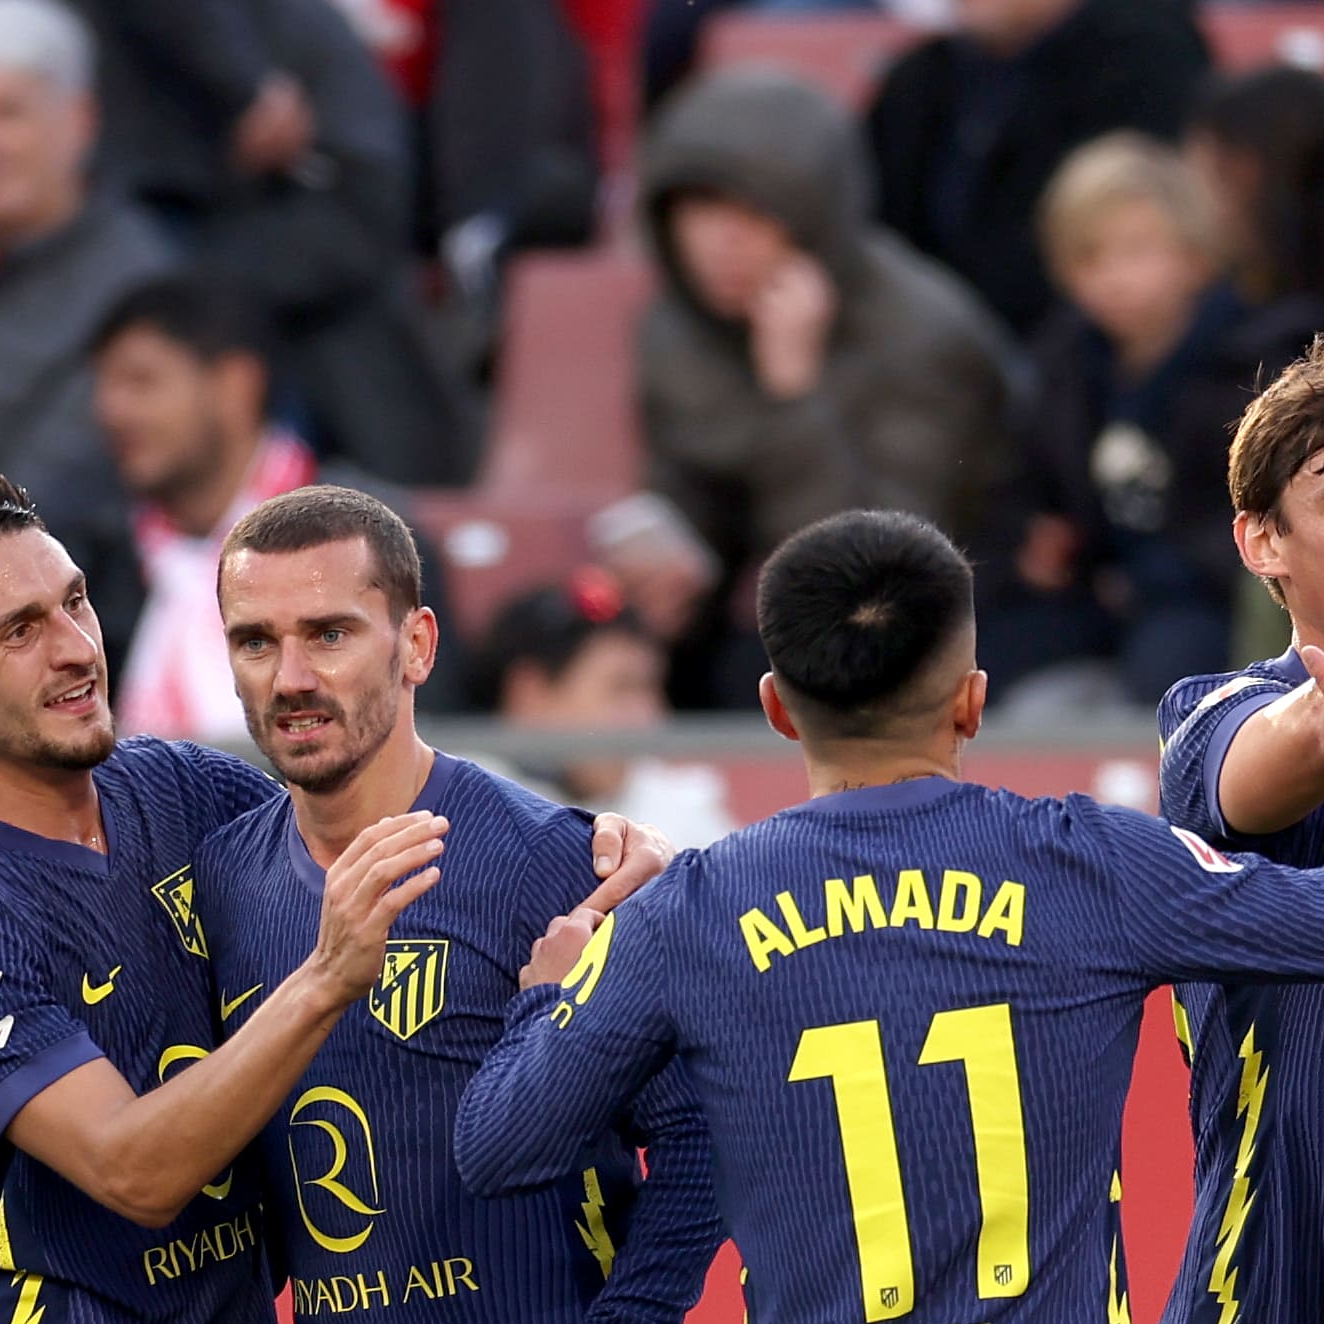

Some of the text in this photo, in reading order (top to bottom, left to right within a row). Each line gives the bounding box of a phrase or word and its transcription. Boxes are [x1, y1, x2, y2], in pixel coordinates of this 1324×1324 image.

[738, 869, 1026, 972] ALMADA
[787, 1003, 1031, 1322] 11
[142, 1215, 256, 1286] RIYADH
[403, 1257, 480, 1304] AIR
